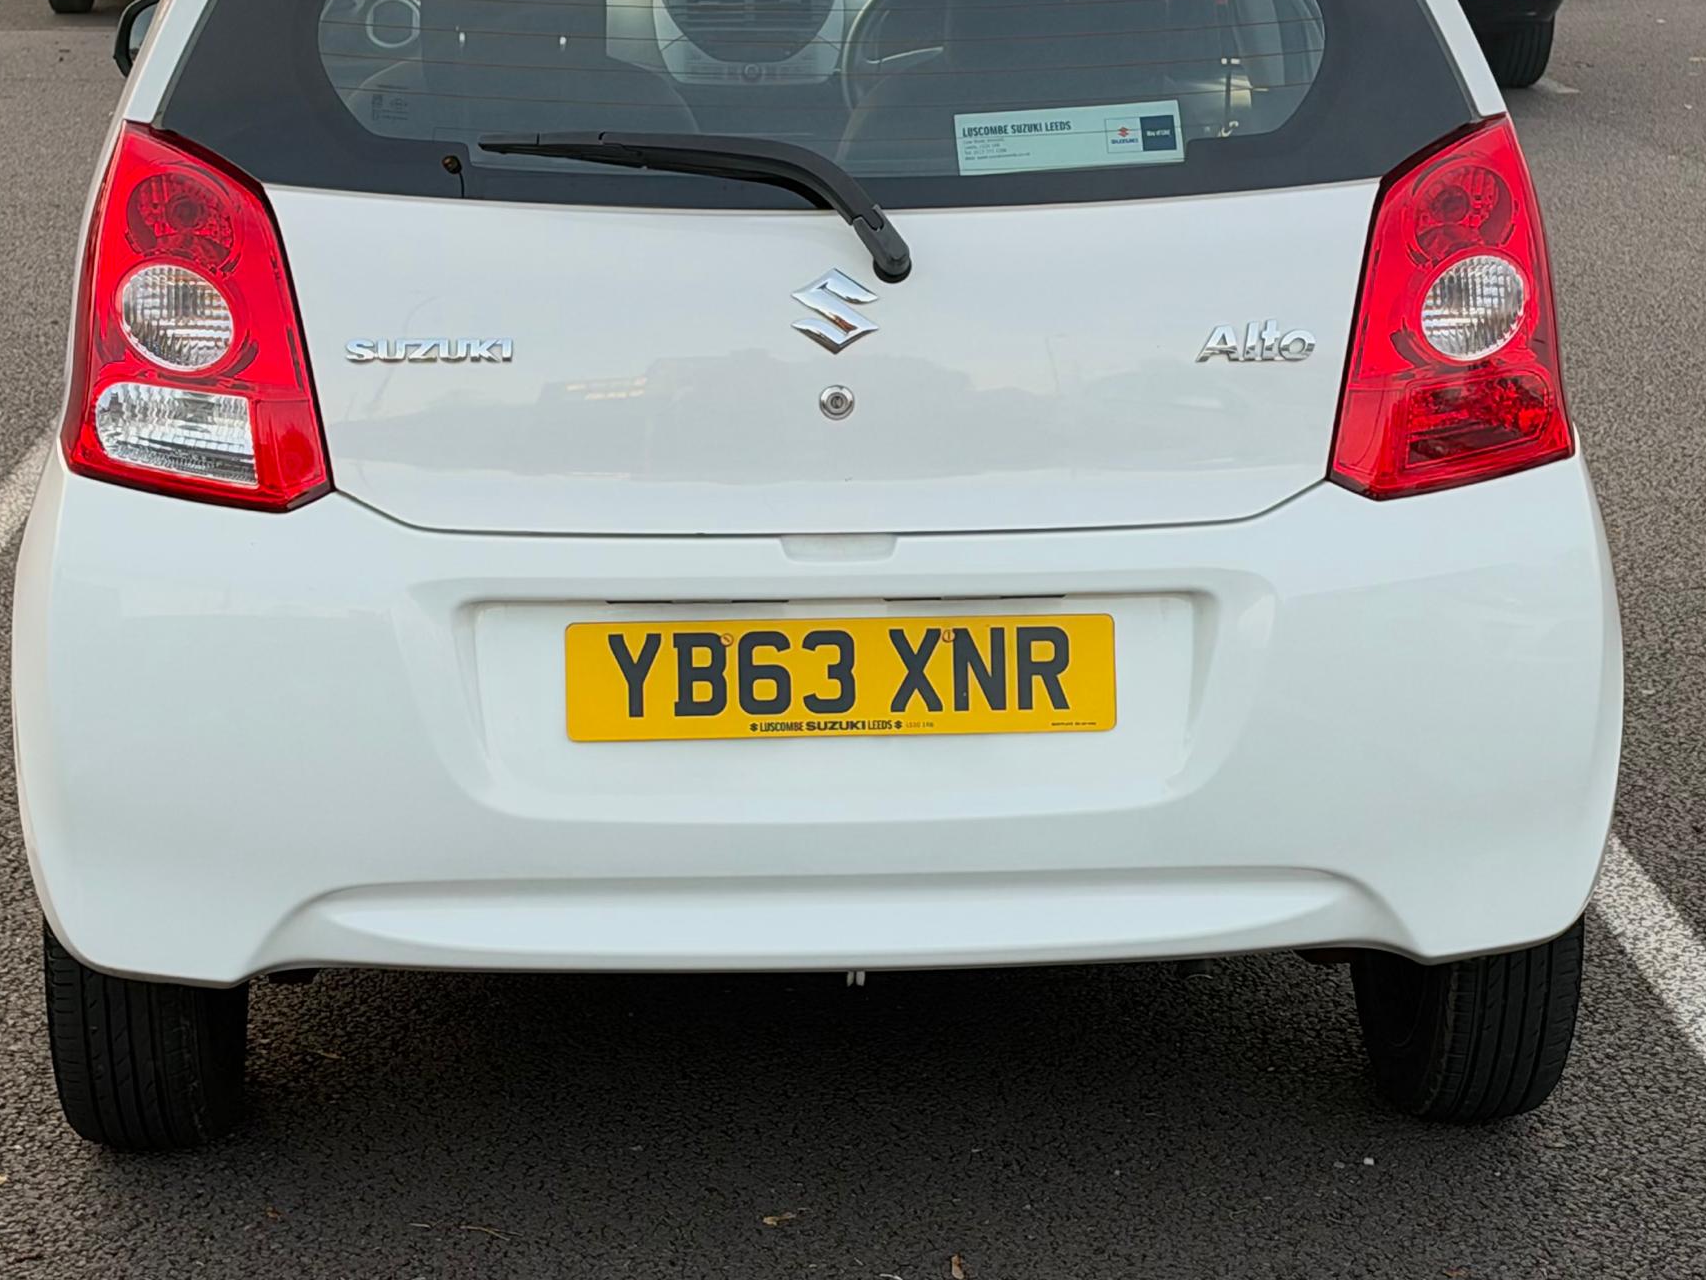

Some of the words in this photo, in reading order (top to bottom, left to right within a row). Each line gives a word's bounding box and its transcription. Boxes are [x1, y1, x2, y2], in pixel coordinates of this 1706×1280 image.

[962, 124, 1009, 138] LUSCOMBE
[1011, 122, 1043, 134] SUZUKI
[1045, 120, 1072, 131] LEEDS
[345, 337, 513, 363] SUZUKI
[1195, 319, 1317, 363] Alto
[607, 630, 856, 718] YB63
[889, 626, 1071, 713] XNR
[759, 721, 804, 732] LUSCOMBE
[806, 720, 867, 731] SUZUKI
[868, 719, 893, 730] LEEDS
